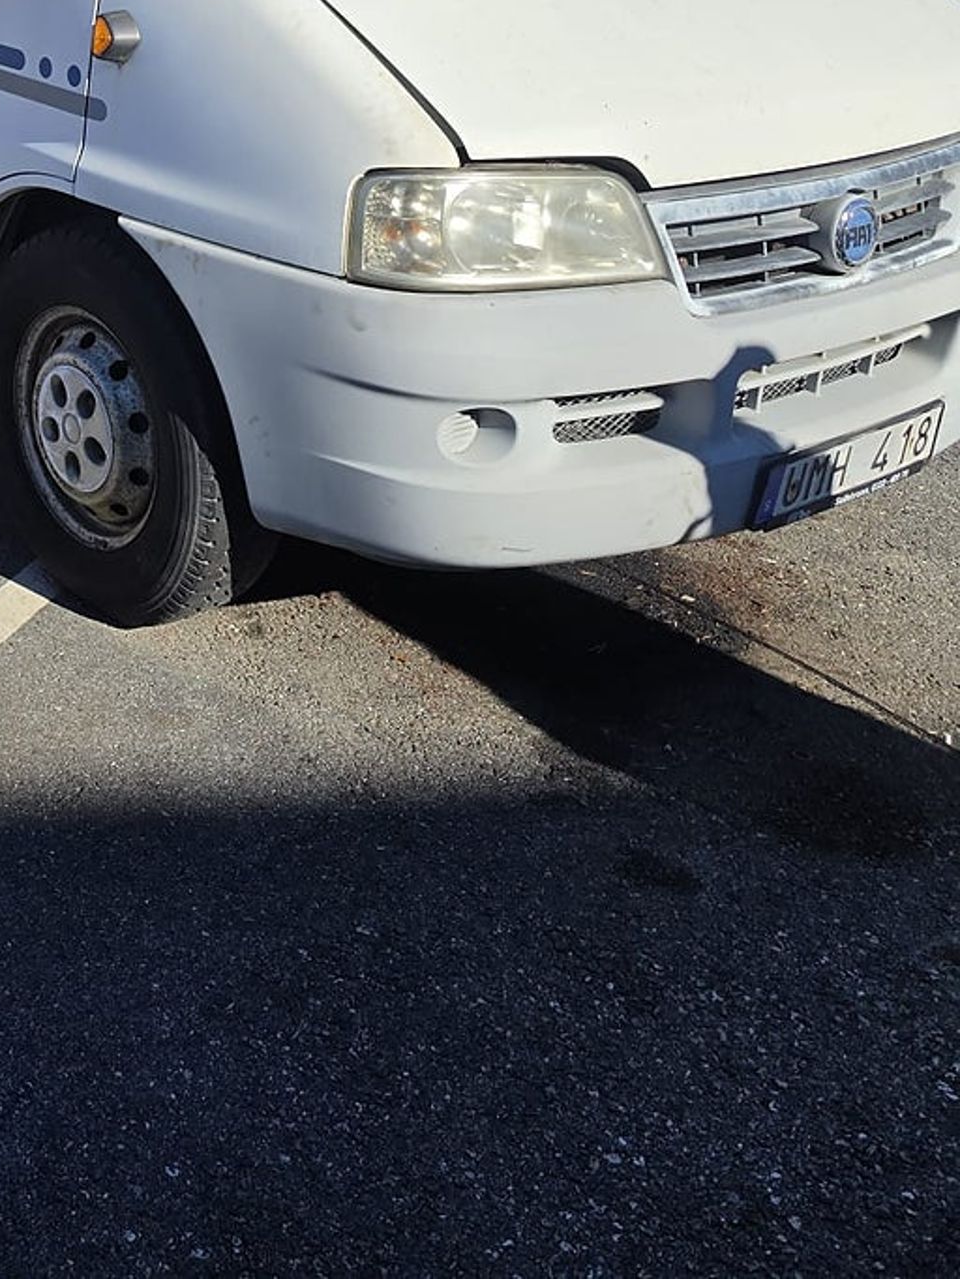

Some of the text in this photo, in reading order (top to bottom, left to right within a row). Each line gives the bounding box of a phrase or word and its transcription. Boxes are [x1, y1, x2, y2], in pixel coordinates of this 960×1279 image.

[843, 223, 872, 251] FIAT
[782, 445, 853, 507] UMH
[870, 415, 932, 472] 418
